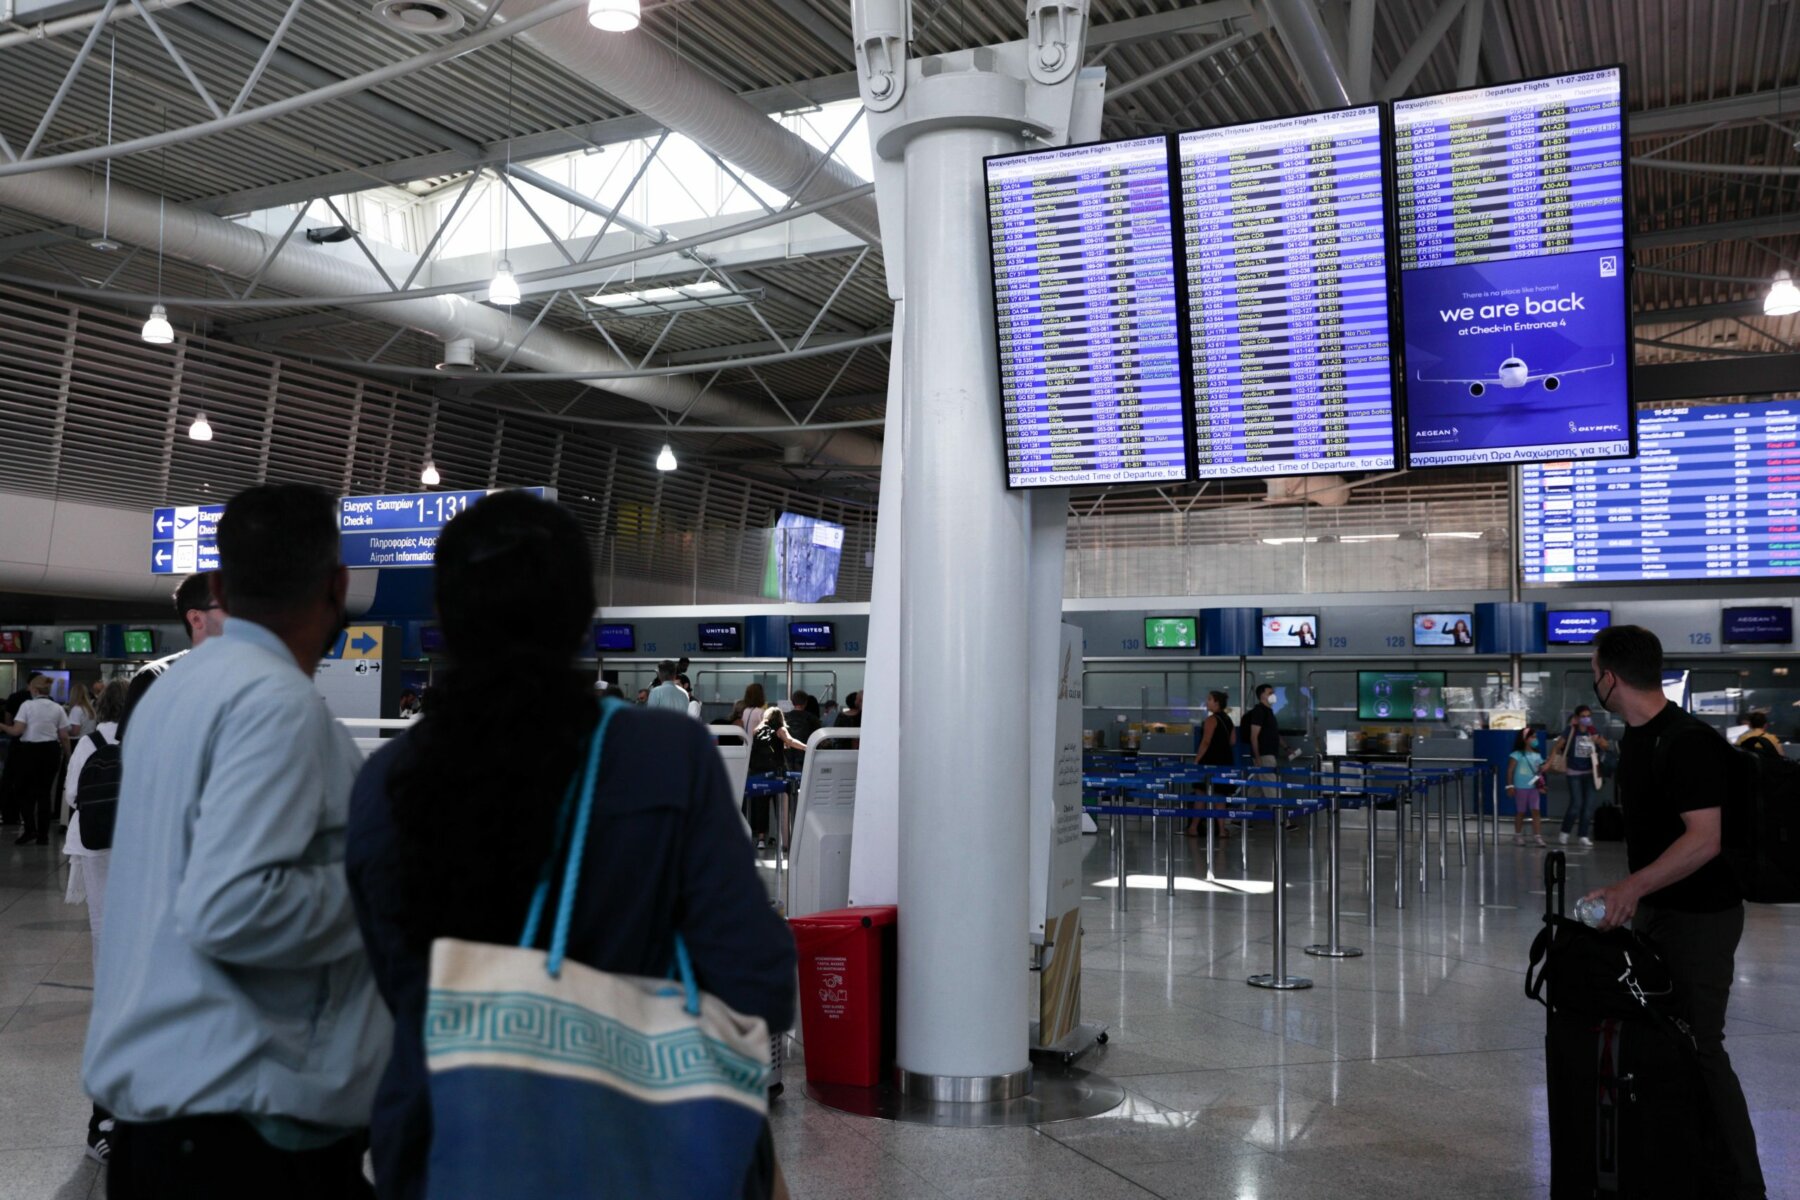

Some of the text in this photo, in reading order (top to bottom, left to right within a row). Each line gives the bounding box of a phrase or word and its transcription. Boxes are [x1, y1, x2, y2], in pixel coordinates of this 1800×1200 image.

[1484, 85, 1521, 97] Departure
[1523, 81, 1549, 91] Flights
[1260, 120, 1292, 130] Departure
[1294, 117, 1317, 126] Flights
[1059, 148, 1088, 158] Departure
[1090, 145, 1111, 154] Flights
[1462, 291, 1481, 299] There
[1501, 286, 1520, 296] place
[1521, 285, 1534, 293] like
[1535, 283, 1558, 292] home!
[1439, 291, 1584, 322] we are back
[1458, 318, 1566, 335] at Check-in Entrance 4
[1490, 450, 1511, 461] Ώρα
[1513, 446, 1577, 459] Αναχώρησης
[1580, 446, 1594, 455] για
[1598, 445, 1610, 454] τις
[1230, 464, 1274, 473] Scheduled
[1278, 462, 1298, 470] Time
[1361, 458, 1372, 466] for
[1020, 476, 1037, 484] prior
[1049, 473, 1089, 481] Scheduled
[344, 515, 373, 526] Check-in
[370, 536, 437, 549] Πληροφορίες Αερο
[370, 552, 394, 563] Airport
[1121, 639, 1139, 650] 130
[1328, 636, 1347, 648] 129
[1688, 633, 1712, 645] 126
